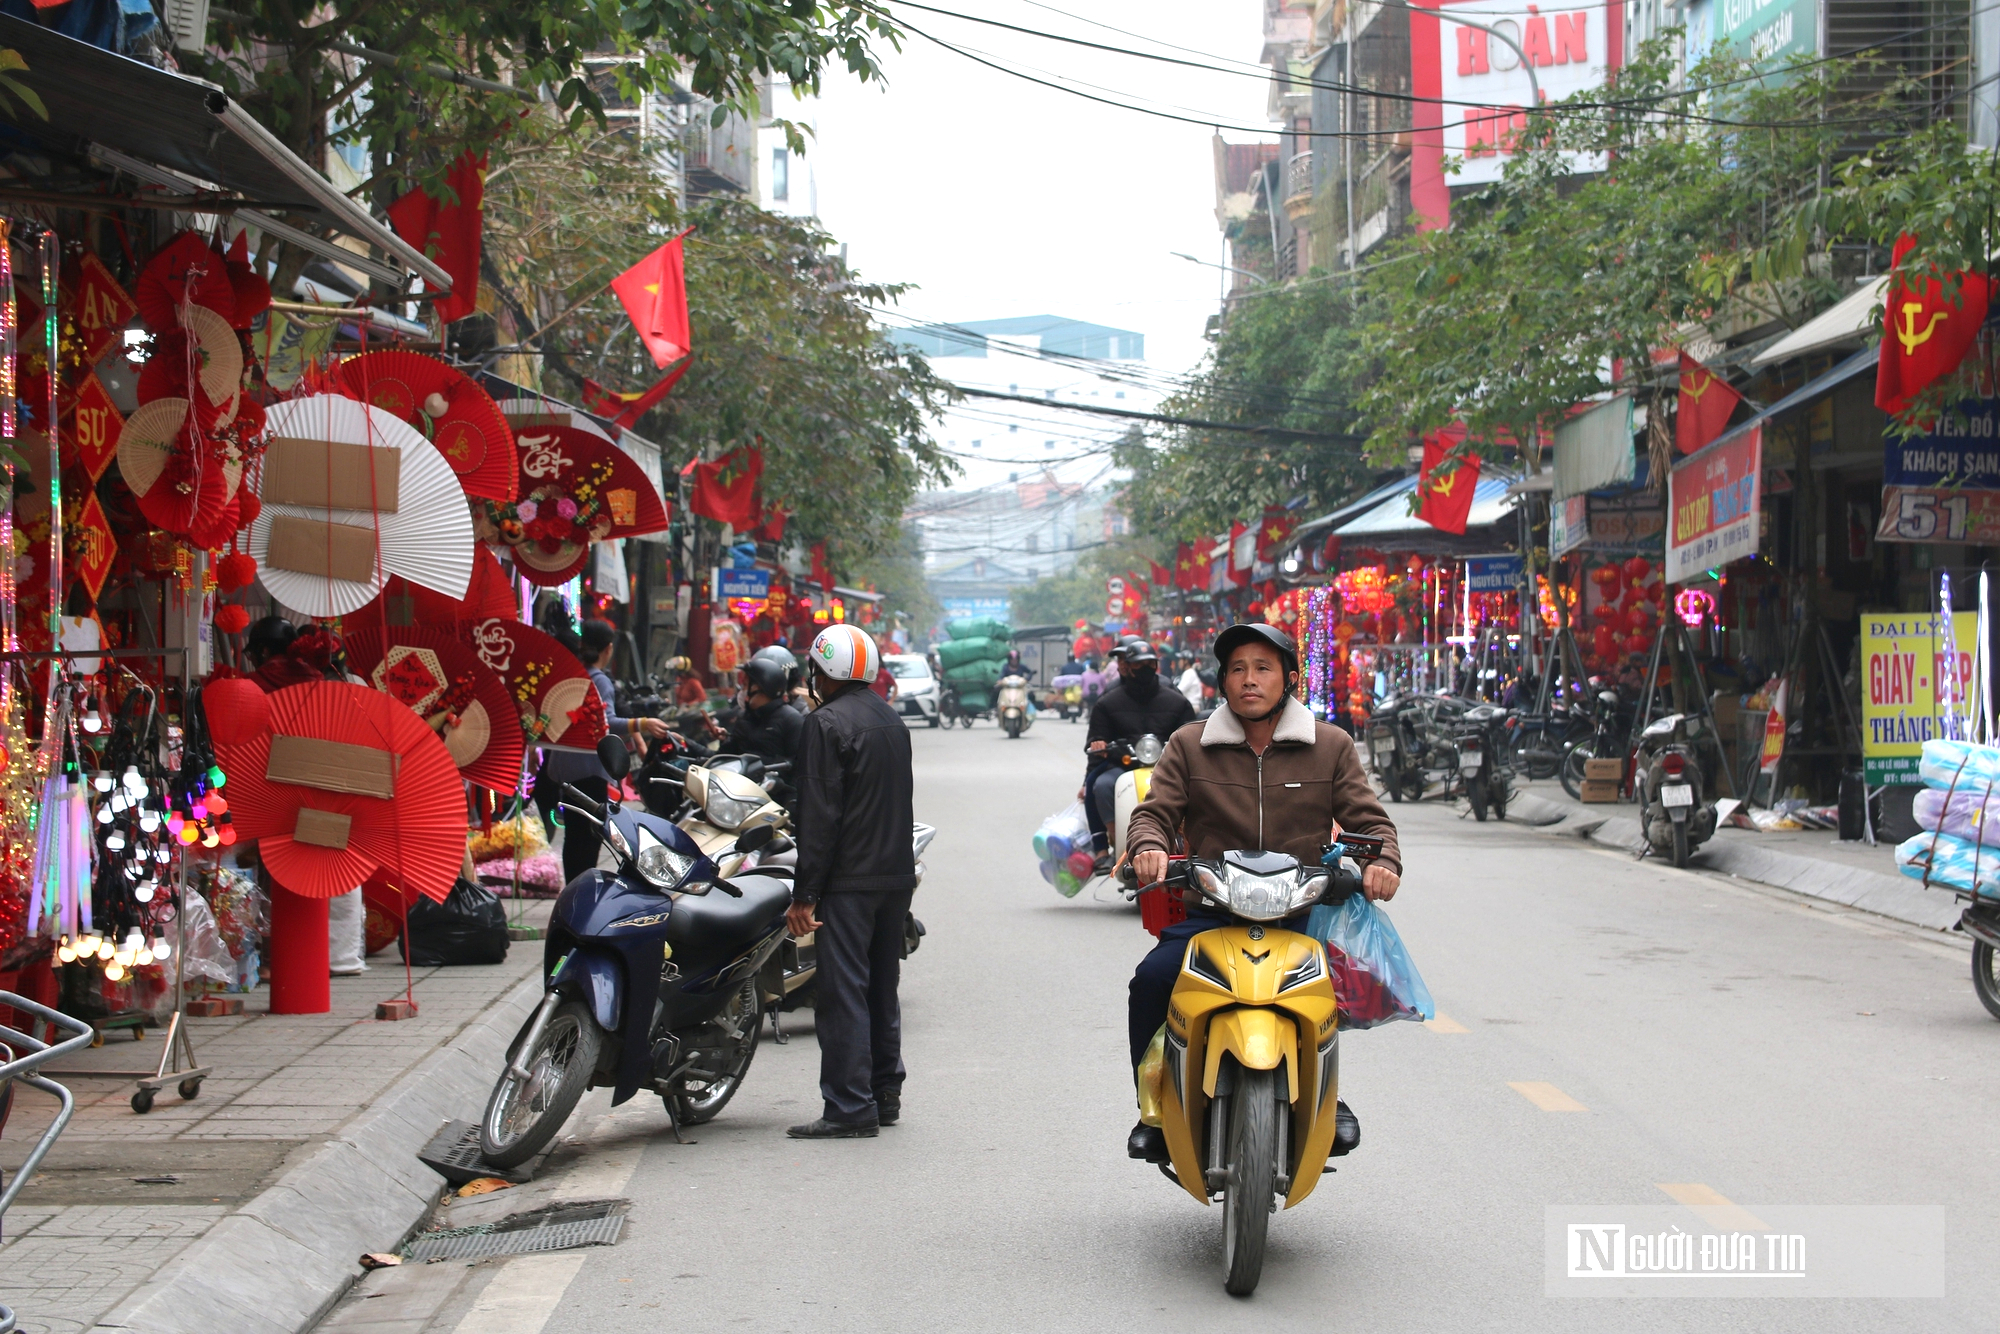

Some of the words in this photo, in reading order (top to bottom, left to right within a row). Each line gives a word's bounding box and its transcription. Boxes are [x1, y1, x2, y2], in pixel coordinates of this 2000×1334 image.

[79, 406, 109, 455] SỰ
[517, 434, 574, 479] Tết
[1902, 447, 1959, 473] KHÁCH
[1896, 494, 1970, 540] 51
[1471, 571, 1502, 588] NGUYỄN
[1870, 622, 1906, 639] ĐẠI
[1869, 642, 1915, 706] GIÀY
[1870, 709, 1932, 744] THẮNG
[1168, 1002, 1187, 1030] YAMAHA
[1319, 1007, 1338, 1036] YAMAHA
